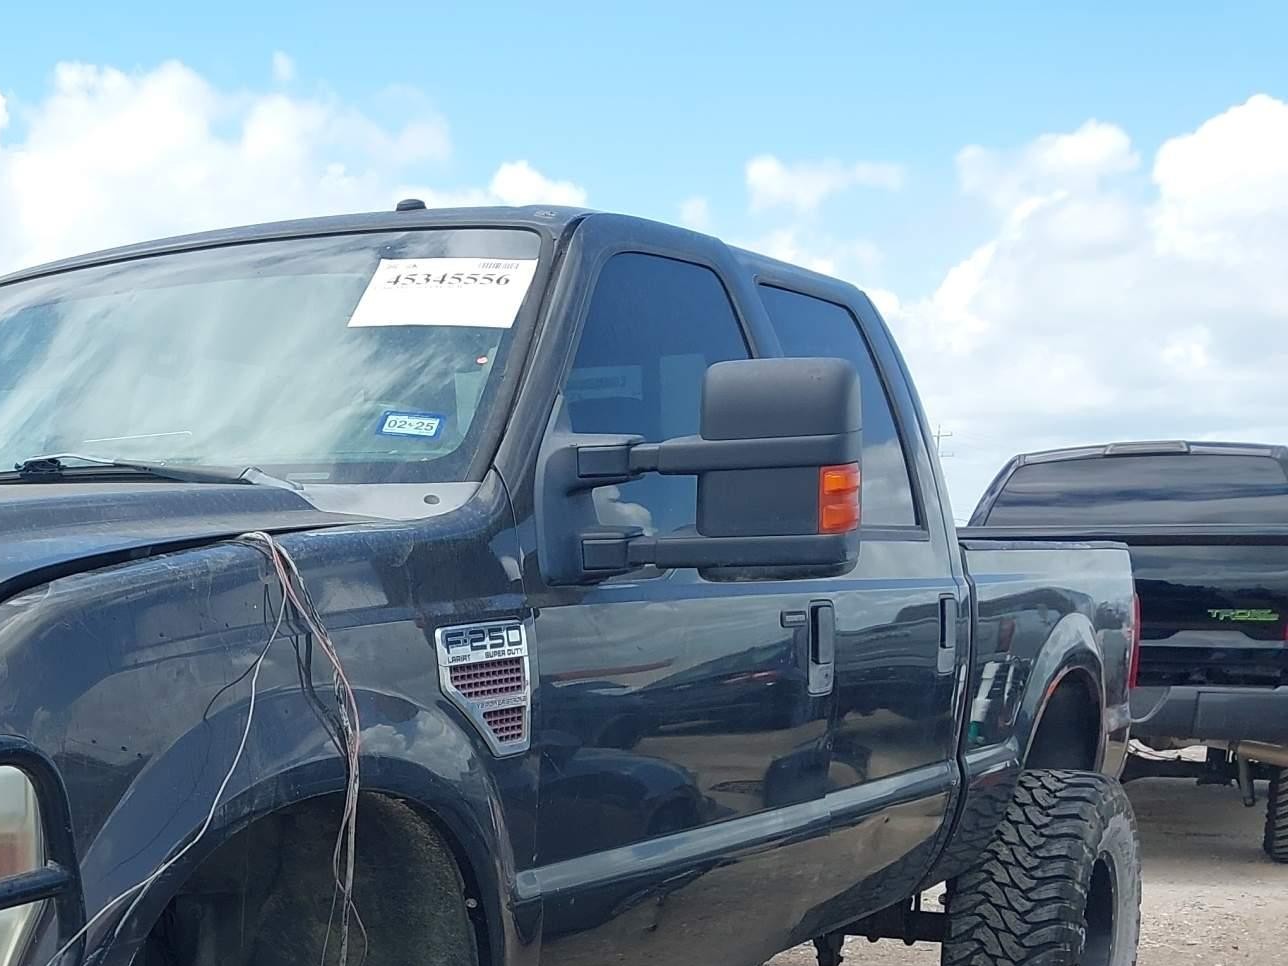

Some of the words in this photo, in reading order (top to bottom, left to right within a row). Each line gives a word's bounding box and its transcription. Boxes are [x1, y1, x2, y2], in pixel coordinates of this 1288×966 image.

[386, 273, 511, 286] 45345556
[445, 626, 523, 655] F-250
[447, 654, 471, 664] LARIAT
[485, 649, 506, 659] SUPER
[507, 647, 524, 656] DUTY
